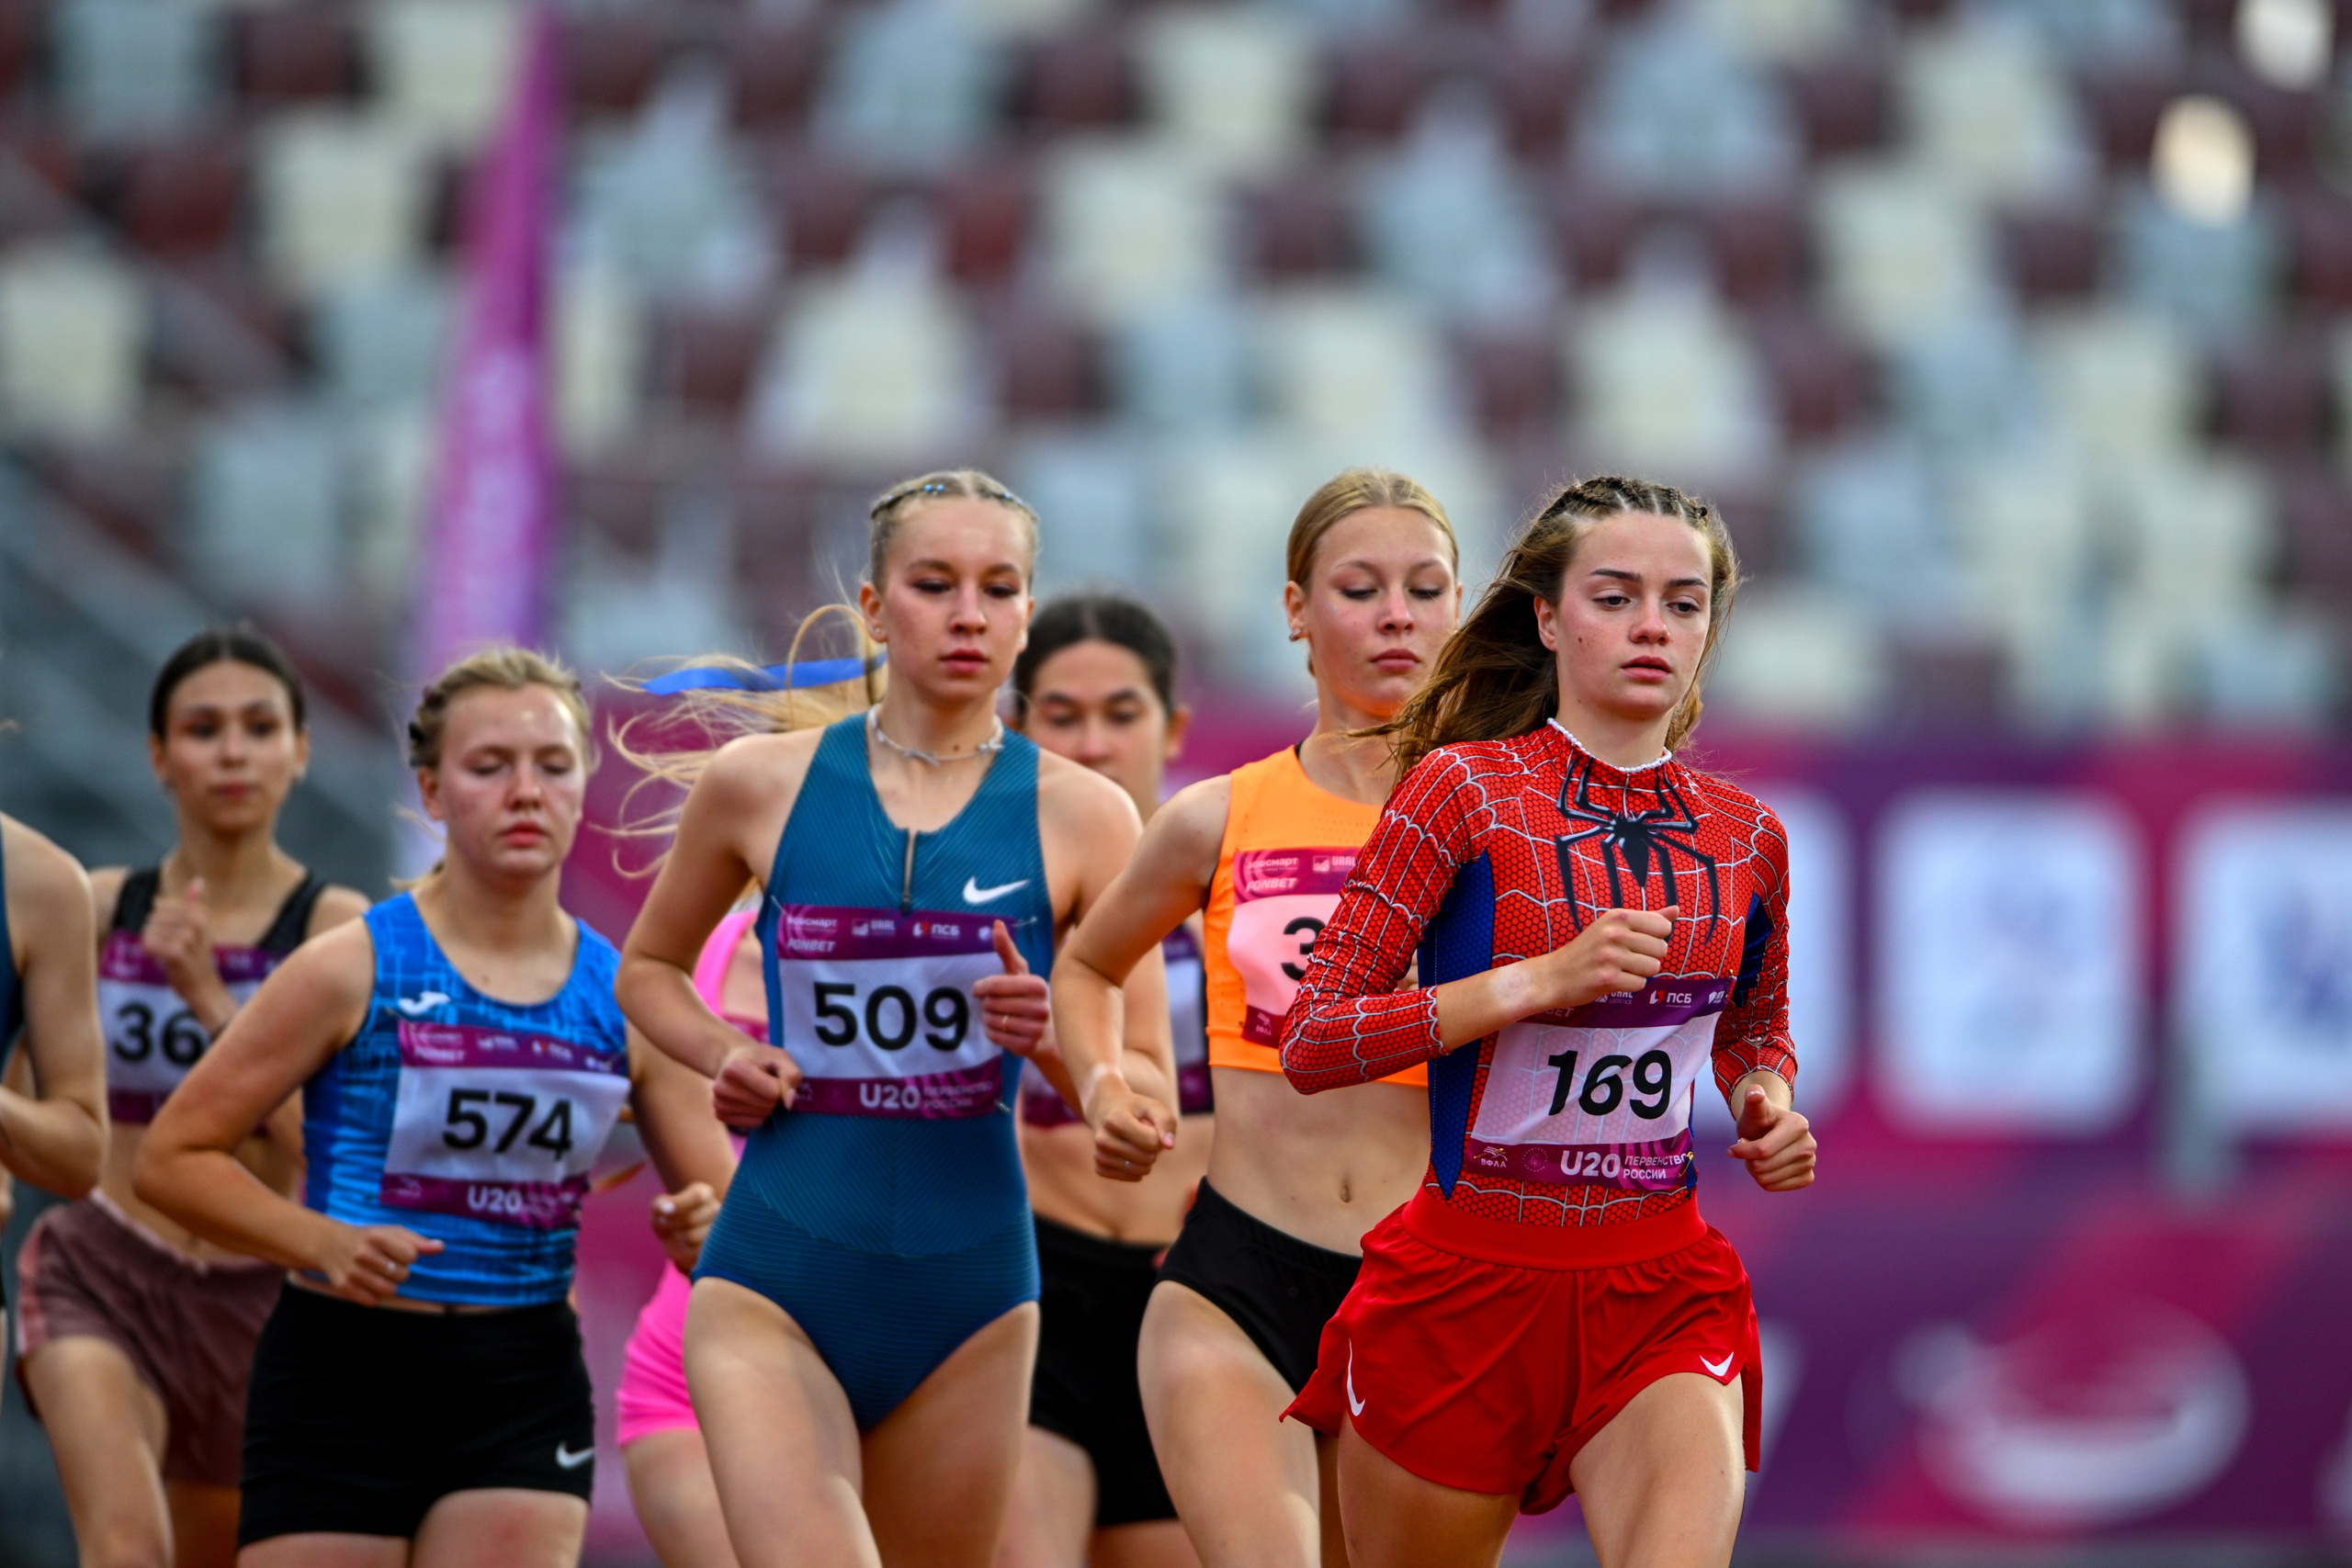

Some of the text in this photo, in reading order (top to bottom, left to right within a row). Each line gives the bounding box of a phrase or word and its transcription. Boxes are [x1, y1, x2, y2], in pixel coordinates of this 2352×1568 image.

[1246, 877, 1297, 891] FONBET
[788, 938, 835, 953] FONBET
[1666, 992, 1692, 1004] ПСБ
[813, 982, 969, 1052] 509
[859, 1083, 920, 1110] U20
[1547, 1049, 1672, 1120] 169
[442, 1089, 574, 1161] 574
[1481, 1157, 1507, 1168] ВФЛА
[1560, 1150, 1621, 1179] U20
[1623, 1168, 1667, 1179] РОССИИ
[467, 1185, 523, 1214] U20
